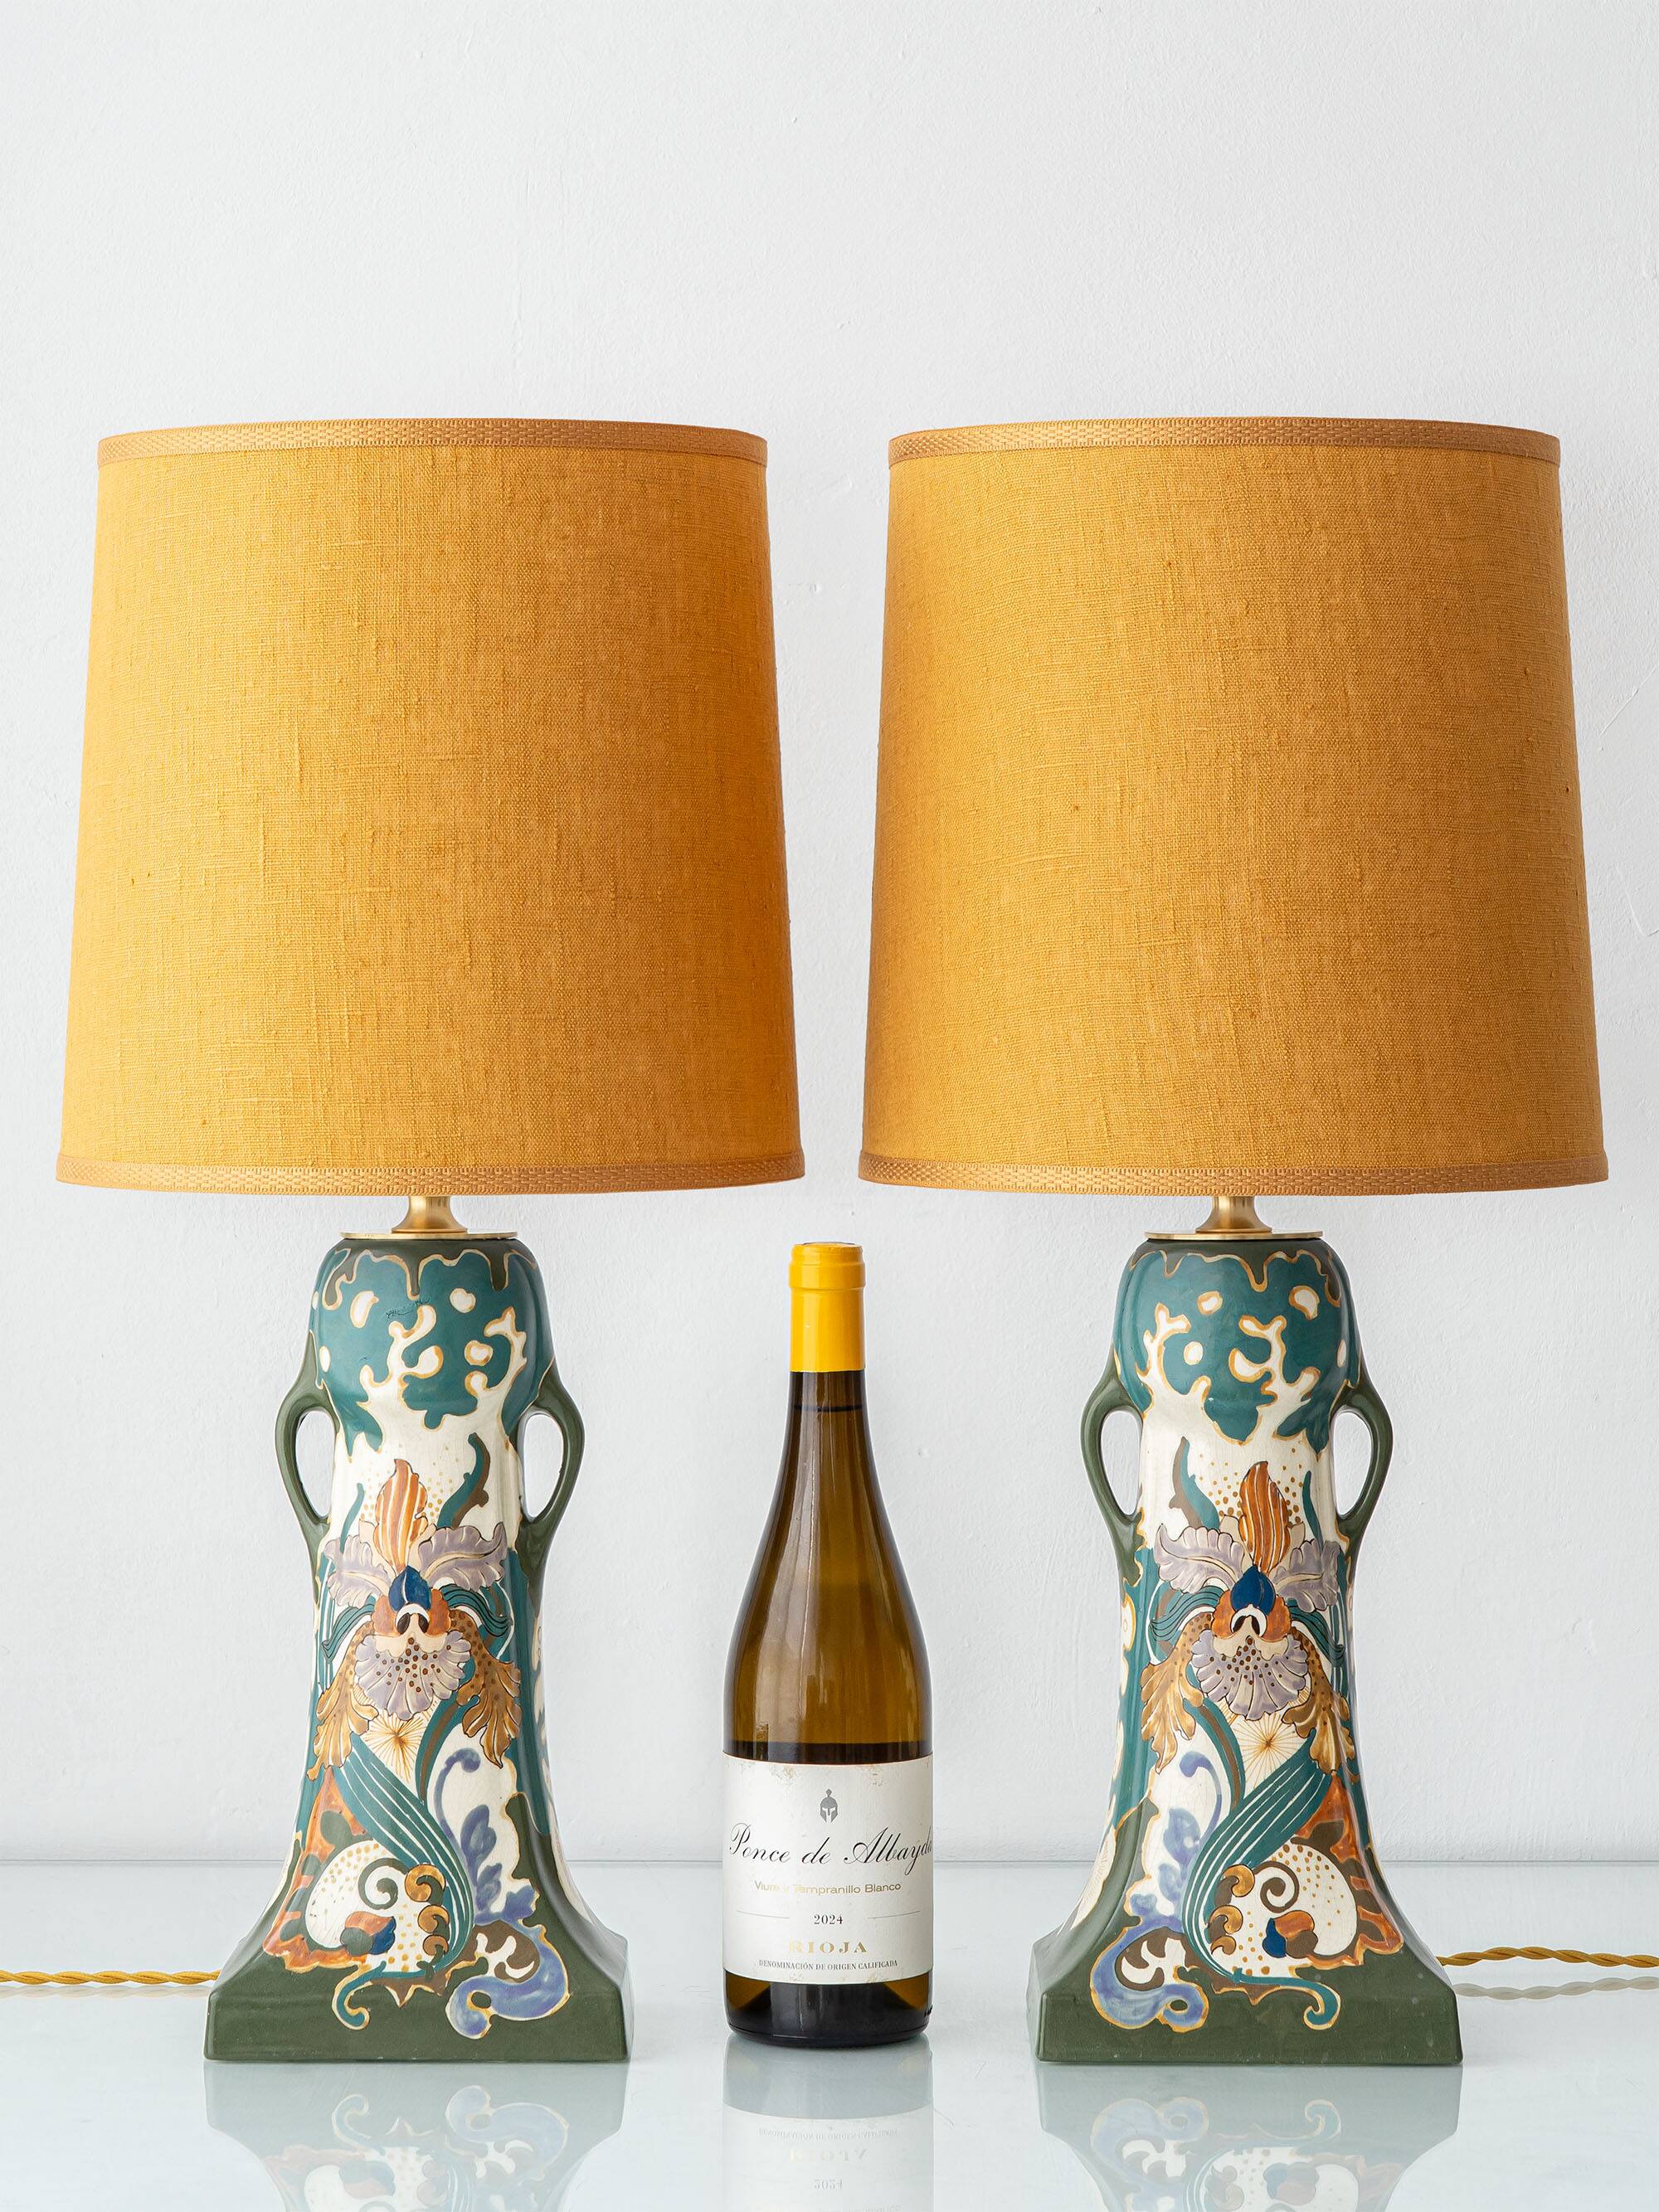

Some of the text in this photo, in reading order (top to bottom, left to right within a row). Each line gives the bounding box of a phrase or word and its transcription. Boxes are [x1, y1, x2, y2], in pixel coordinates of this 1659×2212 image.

[730, 1823, 791, 1863] Ponce
[801, 1837, 831, 1864] de
[793, 1884, 860, 1896] Tempranillo
[865, 1882, 902, 1893] Blanco
[814, 1914, 843, 1925] 2024
[789, 1939, 868, 1954] RIOJA
[759, 1959, 814, 1971] DENOMINACIÓN
[828, 1962, 856, 1971] ORIGEN
[858, 1960, 898, 1970] CALIFICADA
